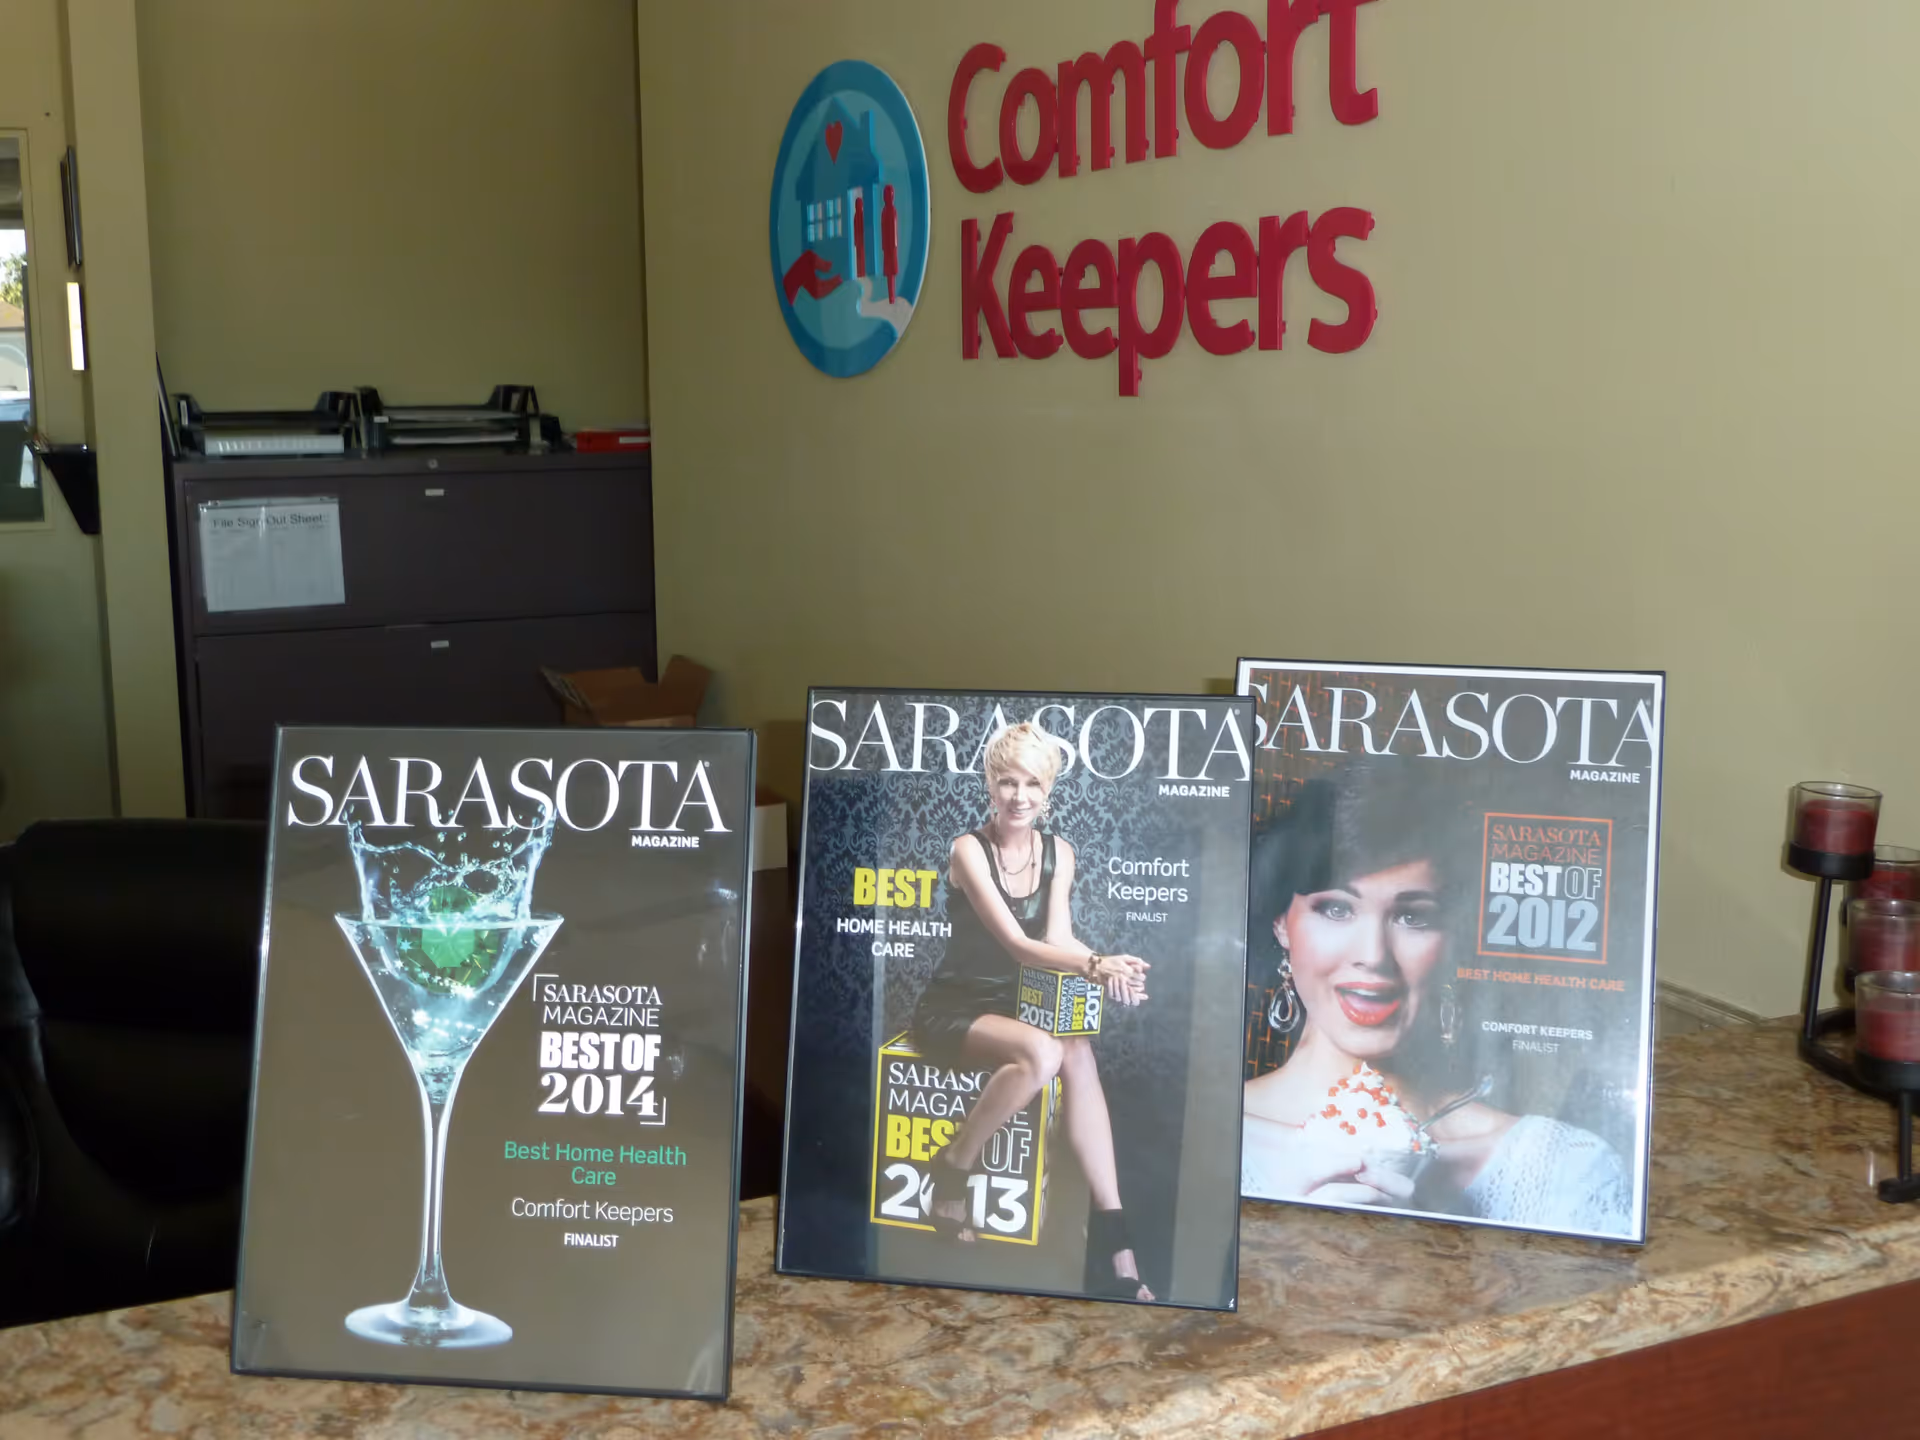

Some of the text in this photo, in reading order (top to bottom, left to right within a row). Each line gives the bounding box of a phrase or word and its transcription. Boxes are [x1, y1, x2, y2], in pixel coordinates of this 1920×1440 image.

[948, 0, 1378, 193] Comfort
[961, 207, 1377, 397] Keepers
[213, 517, 233, 528] File
[266, 514, 287, 526] Out
[289, 511, 323, 524] Sheet
[1570, 769, 1641, 784] MAGAZINE
[288, 755, 733, 833] SARASOTA
[1159, 784, 1230, 798] MAGAZINE
[631, 835, 700, 849] MAGAZINE
[1492, 824, 1602, 847] SARASOTA
[1492, 842, 1600, 866] MAGAZINE
[1108, 857, 1190, 877] Comfort
[853, 867, 937, 908] BEST
[1489, 862, 1602, 900] BEST OF
[1107, 882, 1188, 904] Keepers
[836, 917, 952, 938] HOME HEALTH
[1126, 911, 1168, 924] FINALIST
[1487, 895, 1599, 951] 2012
[871, 941, 915, 958] CARE
[1457, 967, 1625, 992] BEST HOME HEALTH CARE
[543, 983, 663, 1006] SARASOTA
[1021, 986, 1043, 1006] BEST
[1065, 979, 1075, 1031] MAGAZINE
[543, 1006, 660, 1027] MAGAZINE
[1019, 1003, 1054, 1032] 2013
[1072, 995, 1086, 1030] BEST
[1481, 1020, 1593, 1041] COMFORT KEEPERS
[540, 1031, 662, 1072] BEST OF
[1512, 1038, 1560, 1053] FINALIST
[538, 1072, 659, 1116] 2014
[505, 1141, 687, 1166] Best Home Health
[886, 1114, 1032, 1174] BES OF
[571, 1166, 617, 1186] Care
[512, 1198, 674, 1226] Comfort Keepers
[563, 1233, 619, 1248] FINALIST
